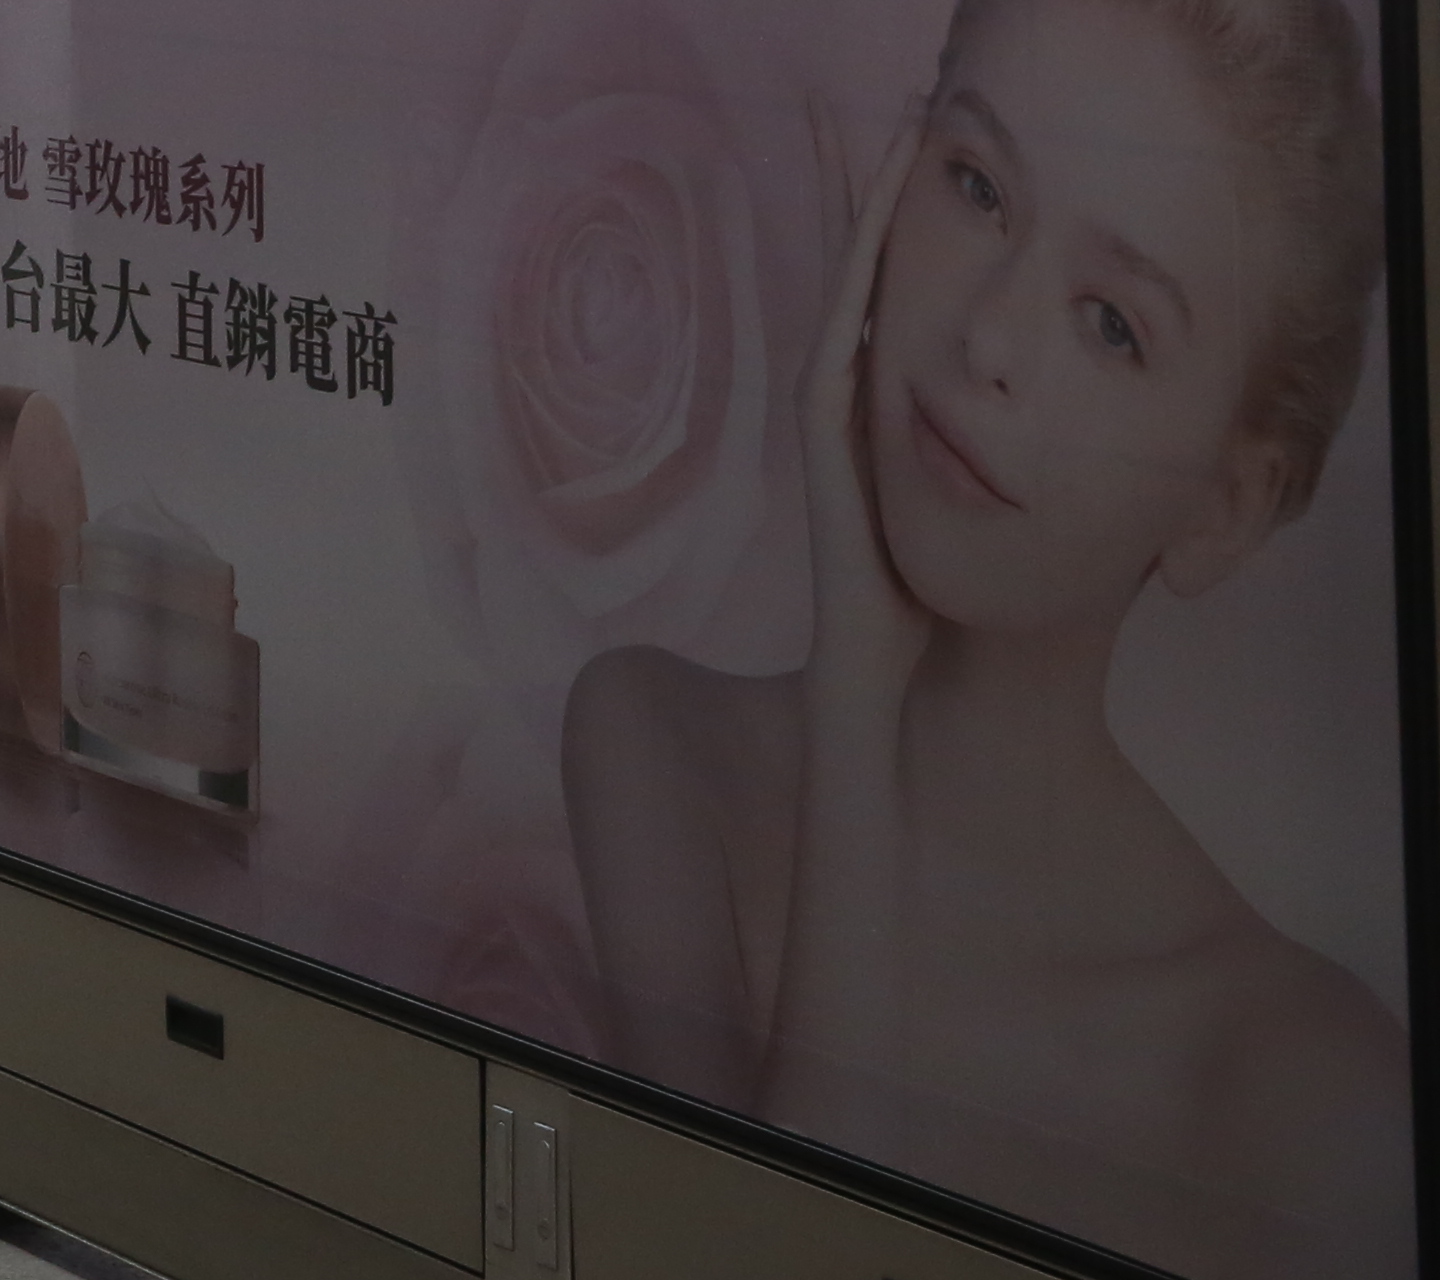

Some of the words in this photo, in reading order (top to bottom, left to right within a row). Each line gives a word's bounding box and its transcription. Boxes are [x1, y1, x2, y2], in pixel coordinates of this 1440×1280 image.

[41, 132, 268, 244] 雪玫瑰系列
[169, 269, 399, 407] 直銷電商
